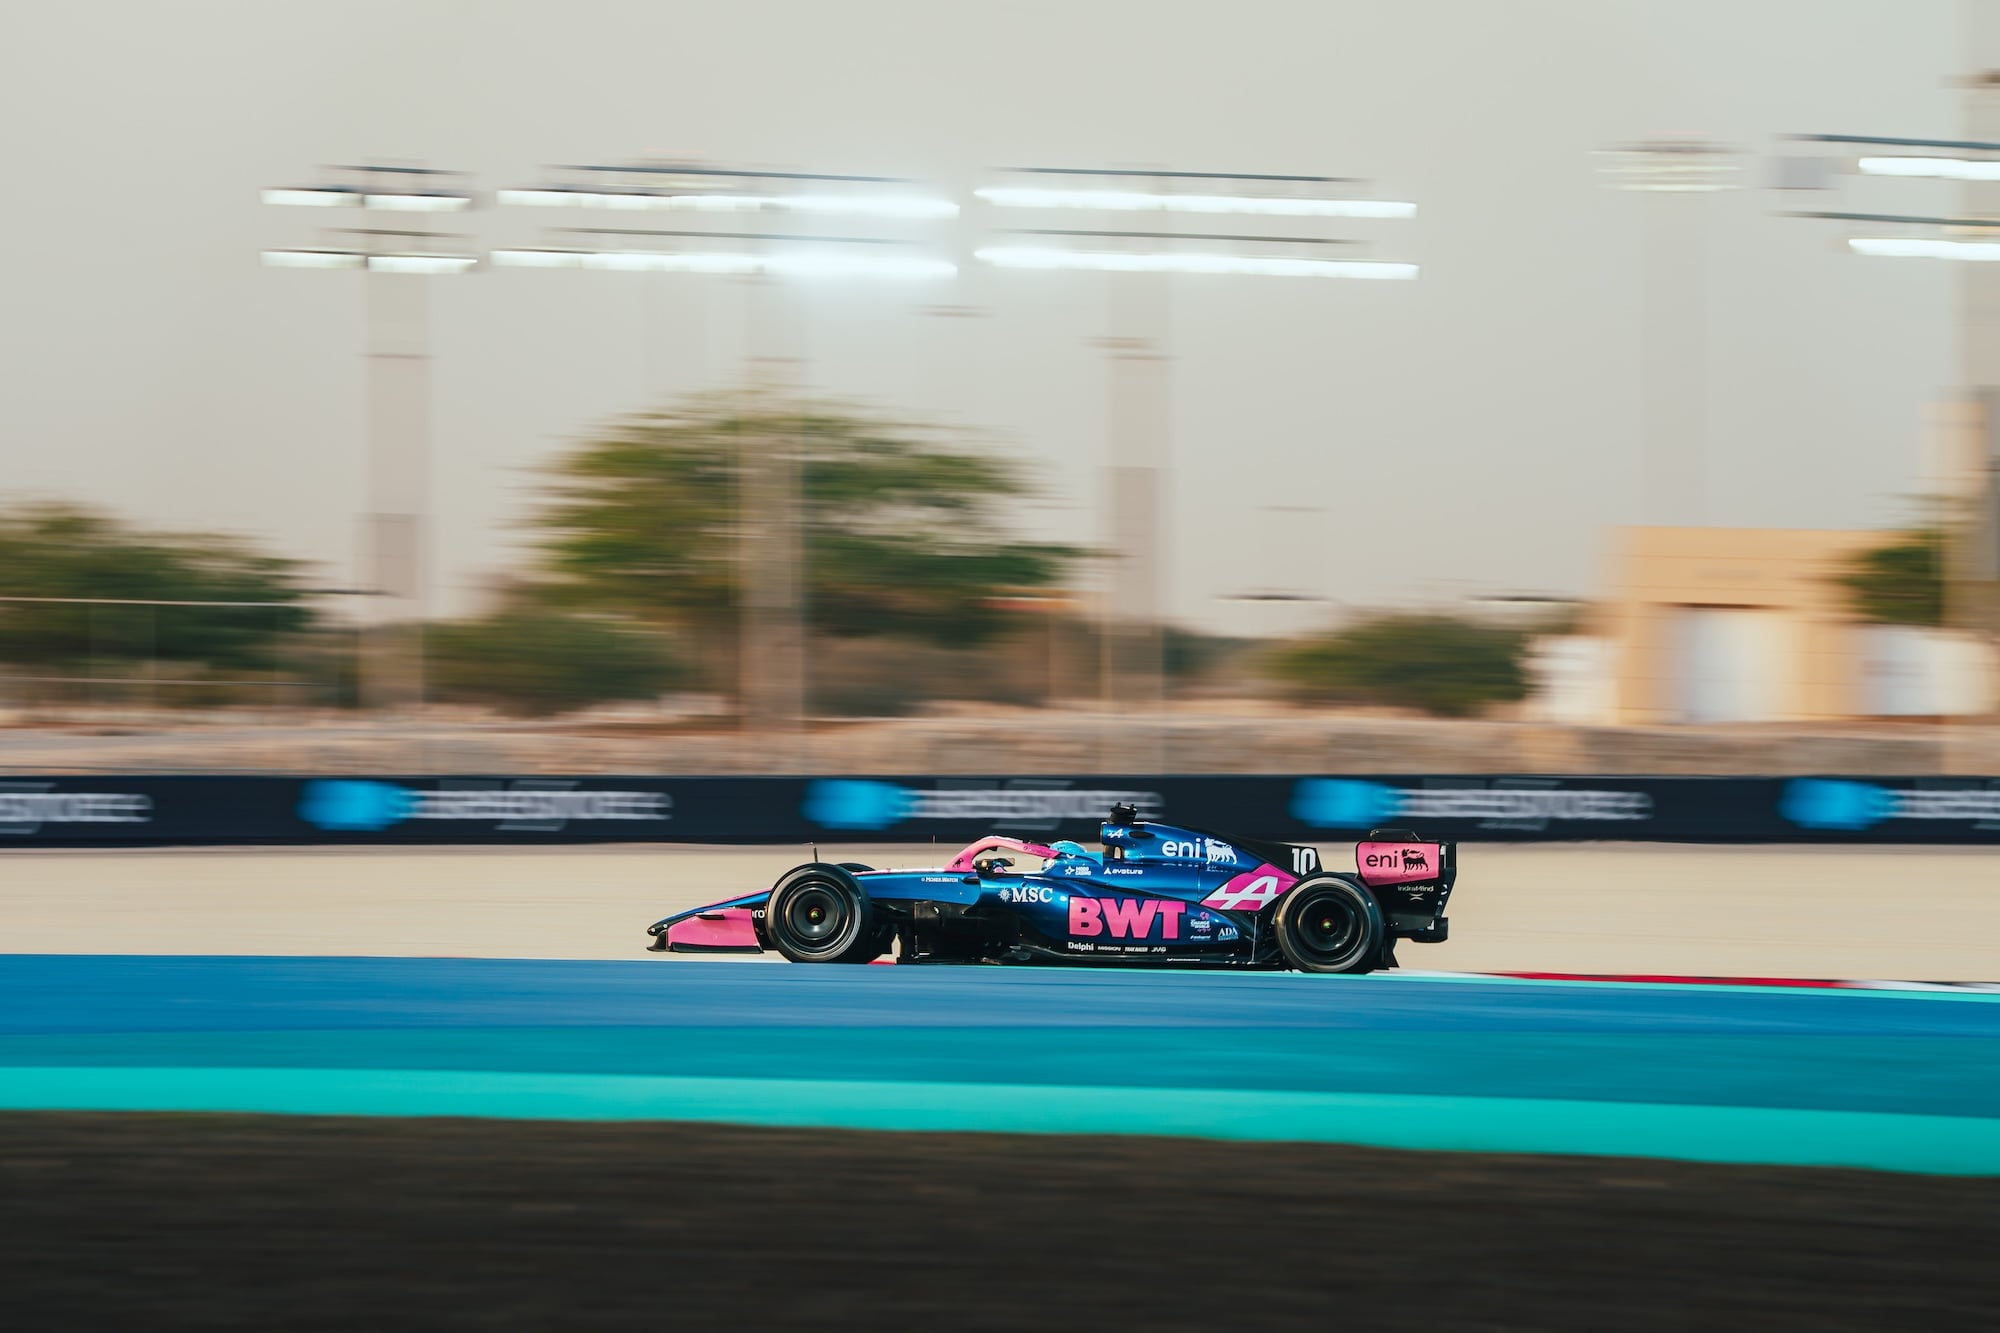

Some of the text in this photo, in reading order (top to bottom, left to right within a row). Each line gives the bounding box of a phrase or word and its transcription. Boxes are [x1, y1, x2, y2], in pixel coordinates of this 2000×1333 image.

[1162, 838, 1201, 859] eni
[1291, 847, 1316, 876] 10
[1365, 850, 1398, 868] eni
[1112, 866, 1143, 875] avature
[1011, 887, 1053, 903] MSC
[1069, 896, 1187, 939] BWT
[1217, 927, 1239, 936] ADA
[1067, 941, 1094, 951] Delphi
